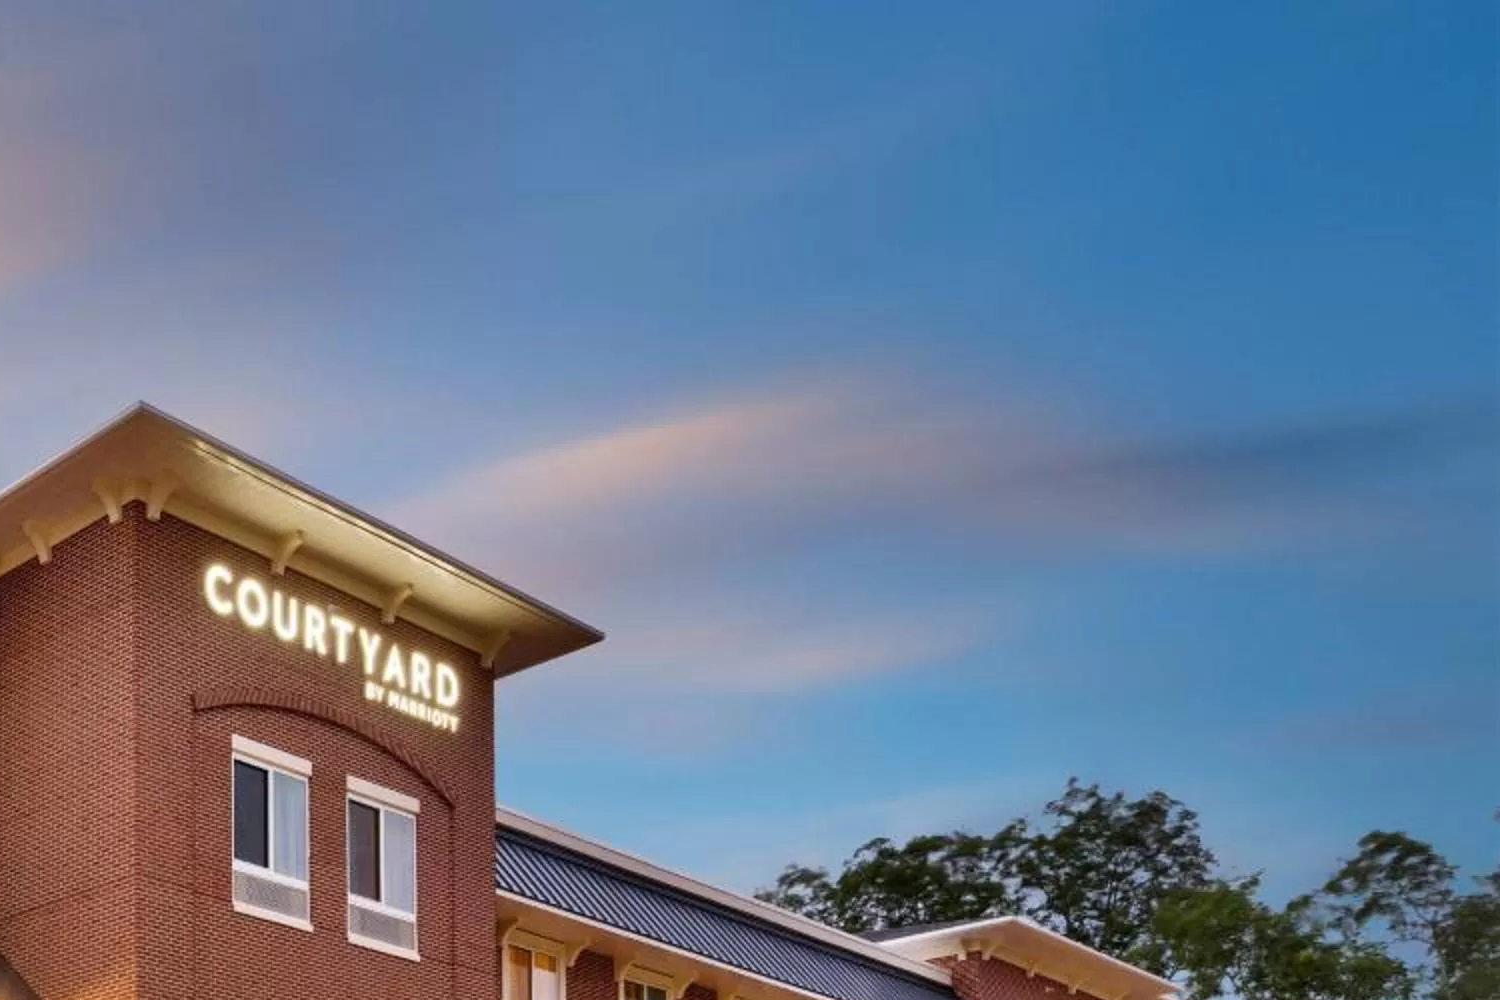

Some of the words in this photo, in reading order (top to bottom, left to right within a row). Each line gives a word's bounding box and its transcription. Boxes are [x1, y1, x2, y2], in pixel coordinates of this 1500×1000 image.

[204, 563, 459, 708] COURTYARD
[364, 680, 385, 703] BY
[387, 690, 460, 734] MARRIOTT
